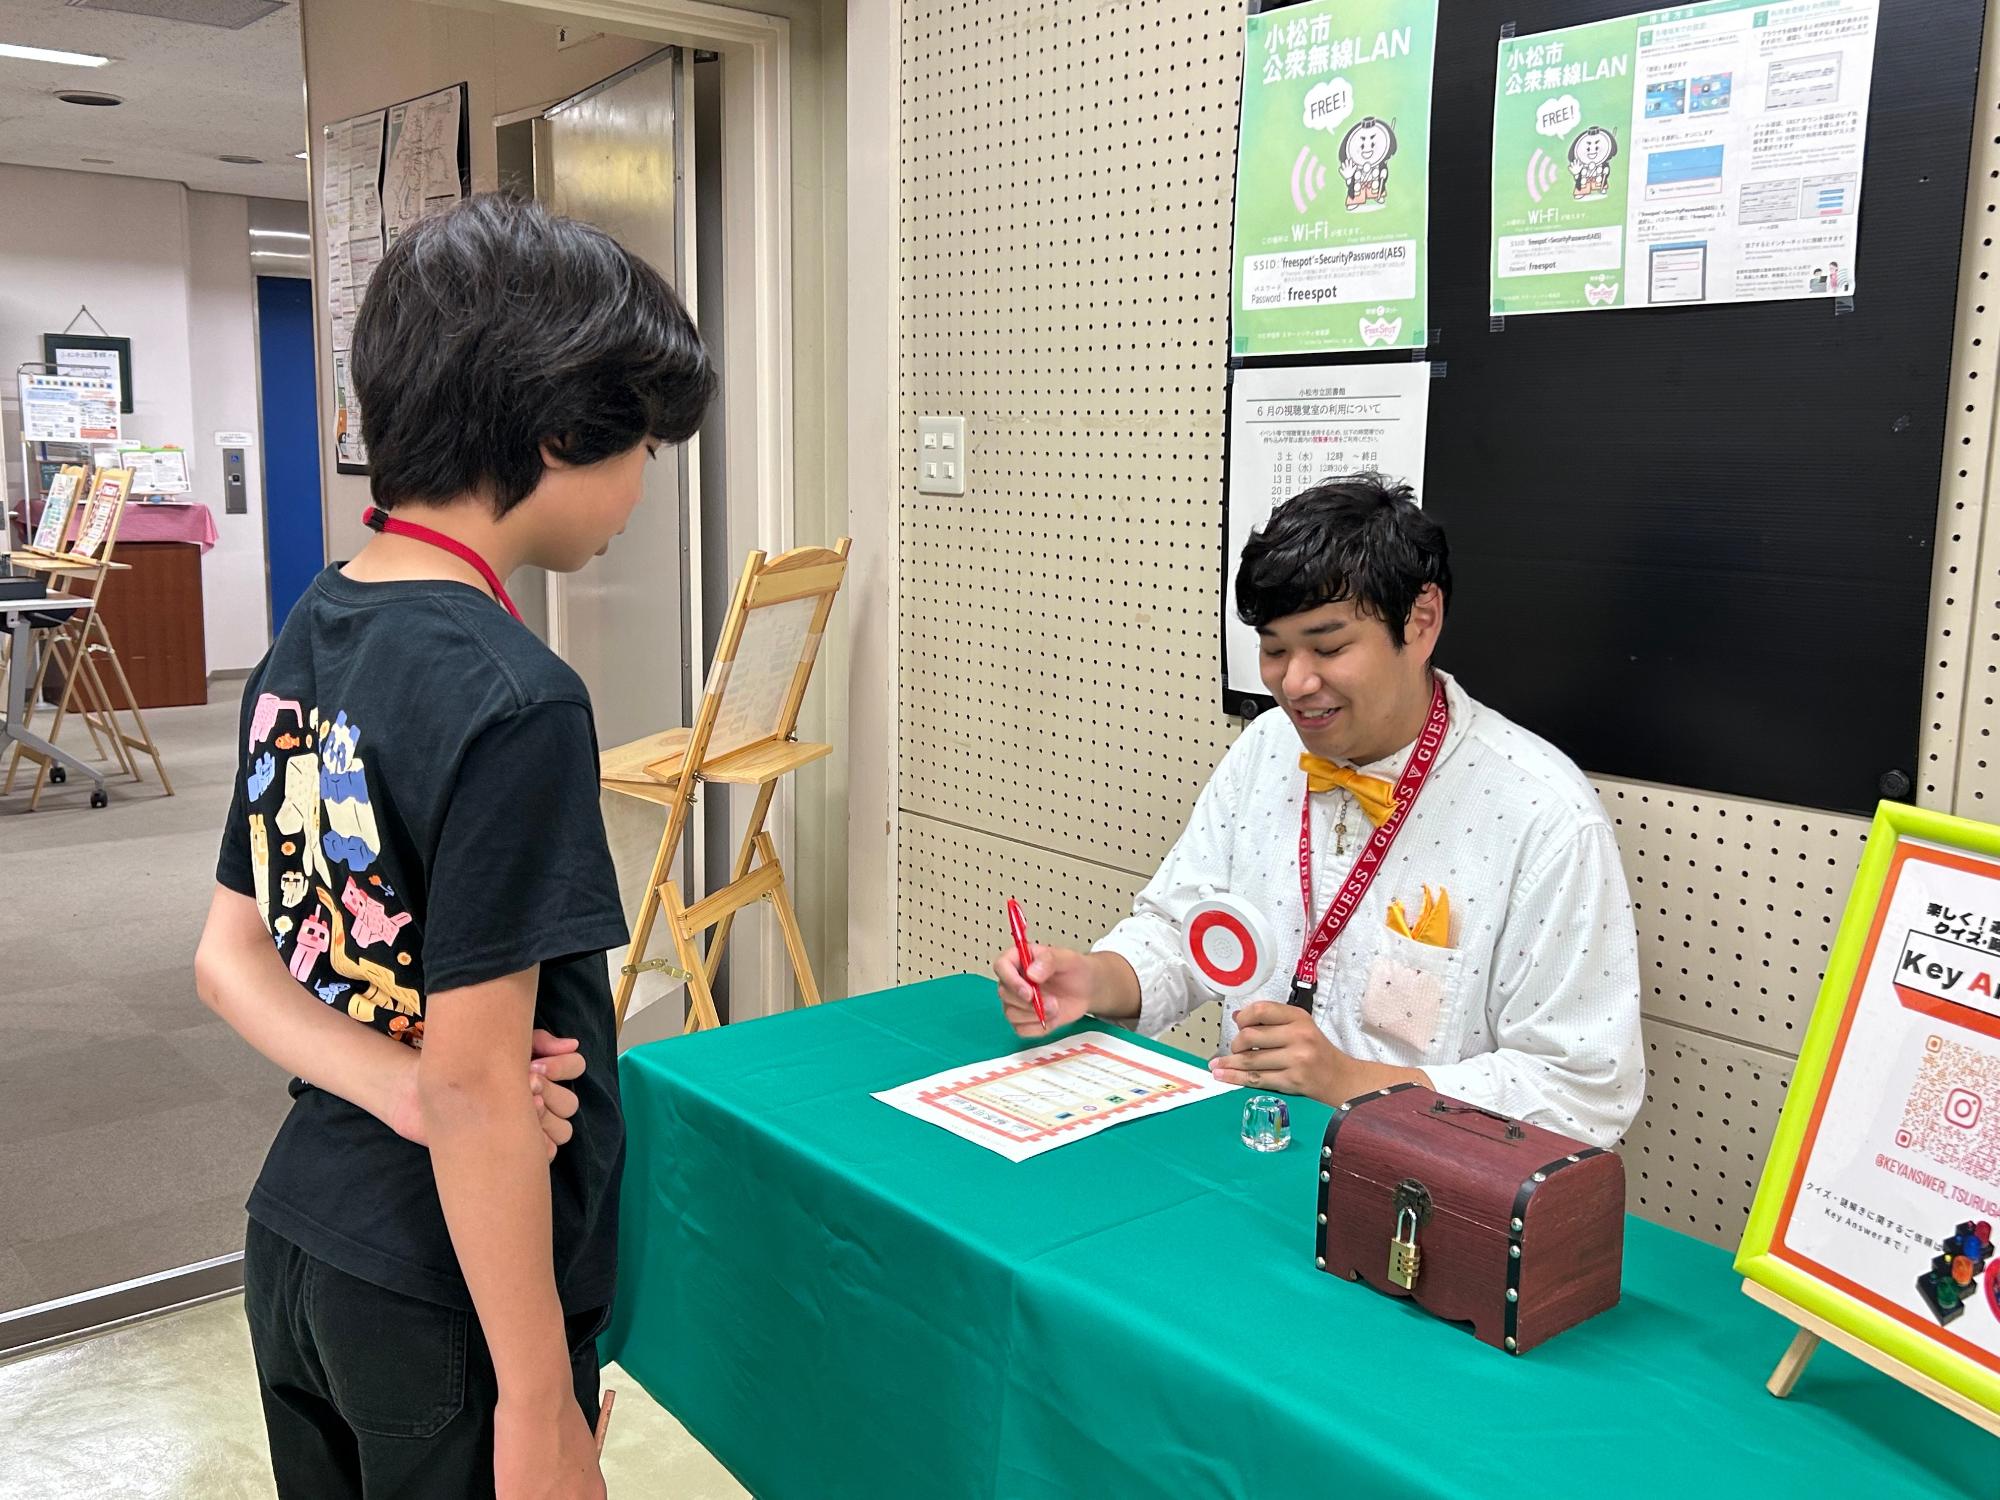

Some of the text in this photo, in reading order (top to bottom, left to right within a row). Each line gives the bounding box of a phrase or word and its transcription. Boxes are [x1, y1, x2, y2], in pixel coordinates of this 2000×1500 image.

[1264, 12, 1332, 54] 小松市
[1262, 27, 1412, 85] 公衆無線LAN
[1507, 41, 1564, 72] 小松市
[1505, 54, 1628, 96] 公衆無線LAN
[1310, 91, 1346, 120] FREE!
[1542, 105, 1575, 128] FREE!
[1528, 208, 1559, 225] Wi-Fi
[1291, 221, 1329, 242] Wi-Fi
[1529, 262, 1557, 271] freespot
[1288, 285, 1338, 303] freespot
[1299, 387, 1346, 396] 小松市立図書館
[1273, 464, 1282, 472] 10
[1277, 452, 1282, 460] 3
[1327, 452, 1343, 461] 12時
[1362, 452, 1377, 461] 終日
[1272, 487, 1281, 495] 20
[1273, 475, 1282, 484] 13
[1417, 700, 1447, 762] GUESS
[1374, 785, 1414, 848] GUESS
[1327, 869, 1369, 929] GUESS
[1902, 949, 1964, 990] Key
[1875, 1153, 2000, 1217] @KEYANSWER_TSURUG
[1824, 1207, 1843, 1222] Key
